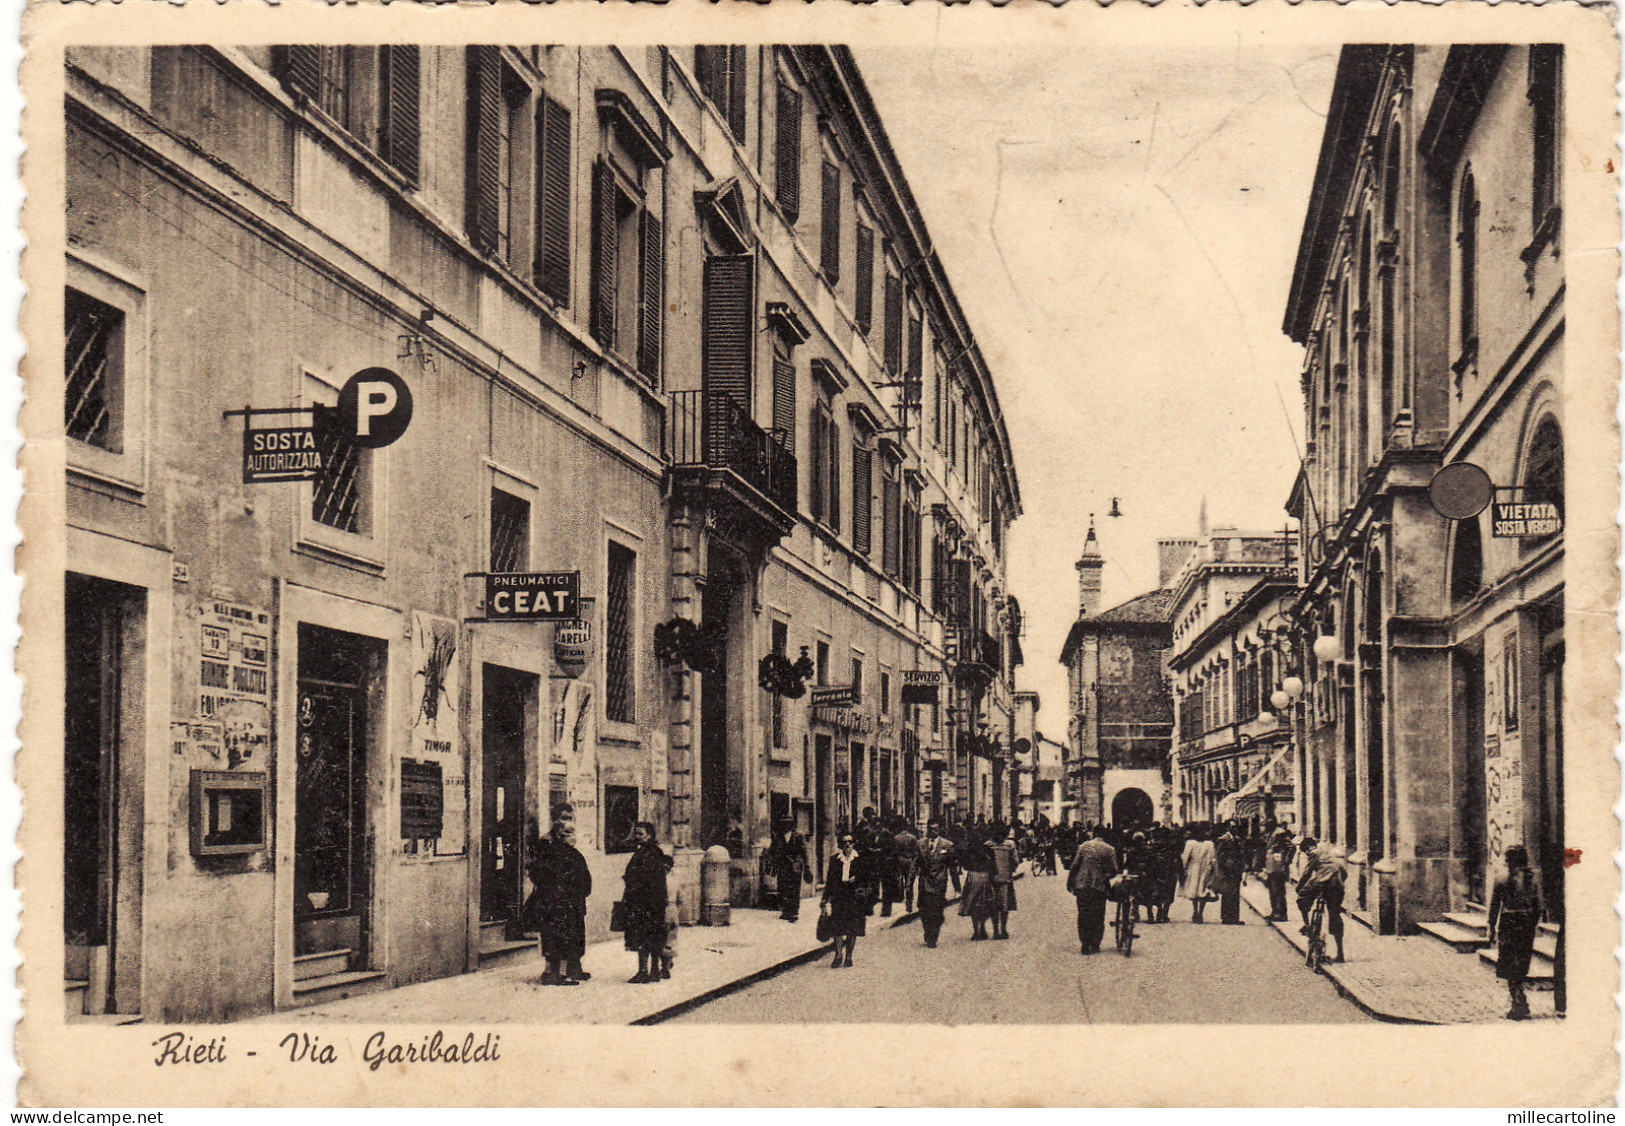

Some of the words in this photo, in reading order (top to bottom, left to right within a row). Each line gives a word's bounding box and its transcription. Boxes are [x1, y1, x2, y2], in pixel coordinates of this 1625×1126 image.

[356, 381, 398, 436] P
[253, 432, 315, 451] SOSTA
[247, 451, 322, 471] AUTORIZZATA
[1499, 504, 1557, 519] VIETATA
[1495, 521, 1526, 535] SOSTA
[494, 576, 569, 586] PNEUMATICI
[494, 591, 569, 614] CEAT
[904, 671, 941, 683] SERVIZIO
[424, 739, 452, 753] TIMOR
[1240, 736, 1250, 748] P
